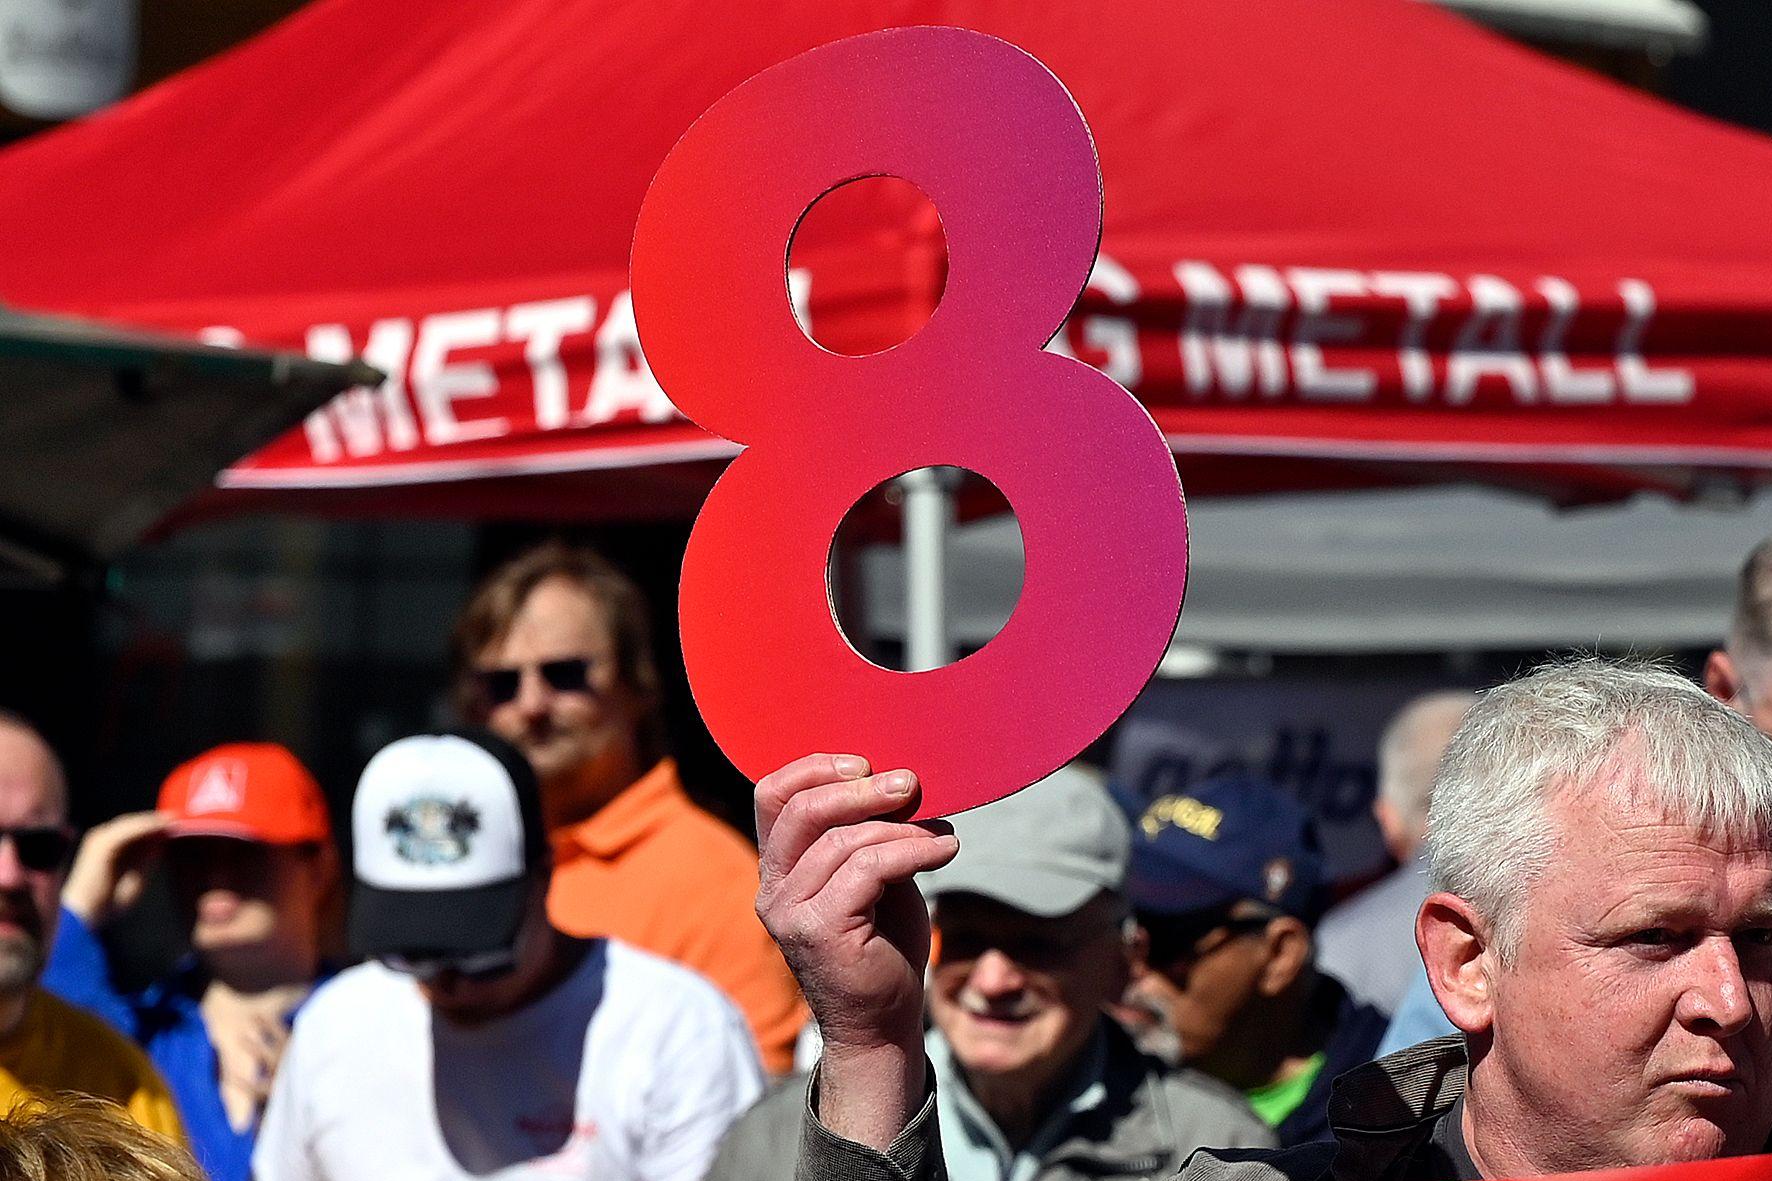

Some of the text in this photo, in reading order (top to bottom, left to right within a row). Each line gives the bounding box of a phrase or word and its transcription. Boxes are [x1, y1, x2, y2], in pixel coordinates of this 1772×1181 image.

[629, 25, 1190, 822] 8
[1040, 251, 1696, 406] G METALL
